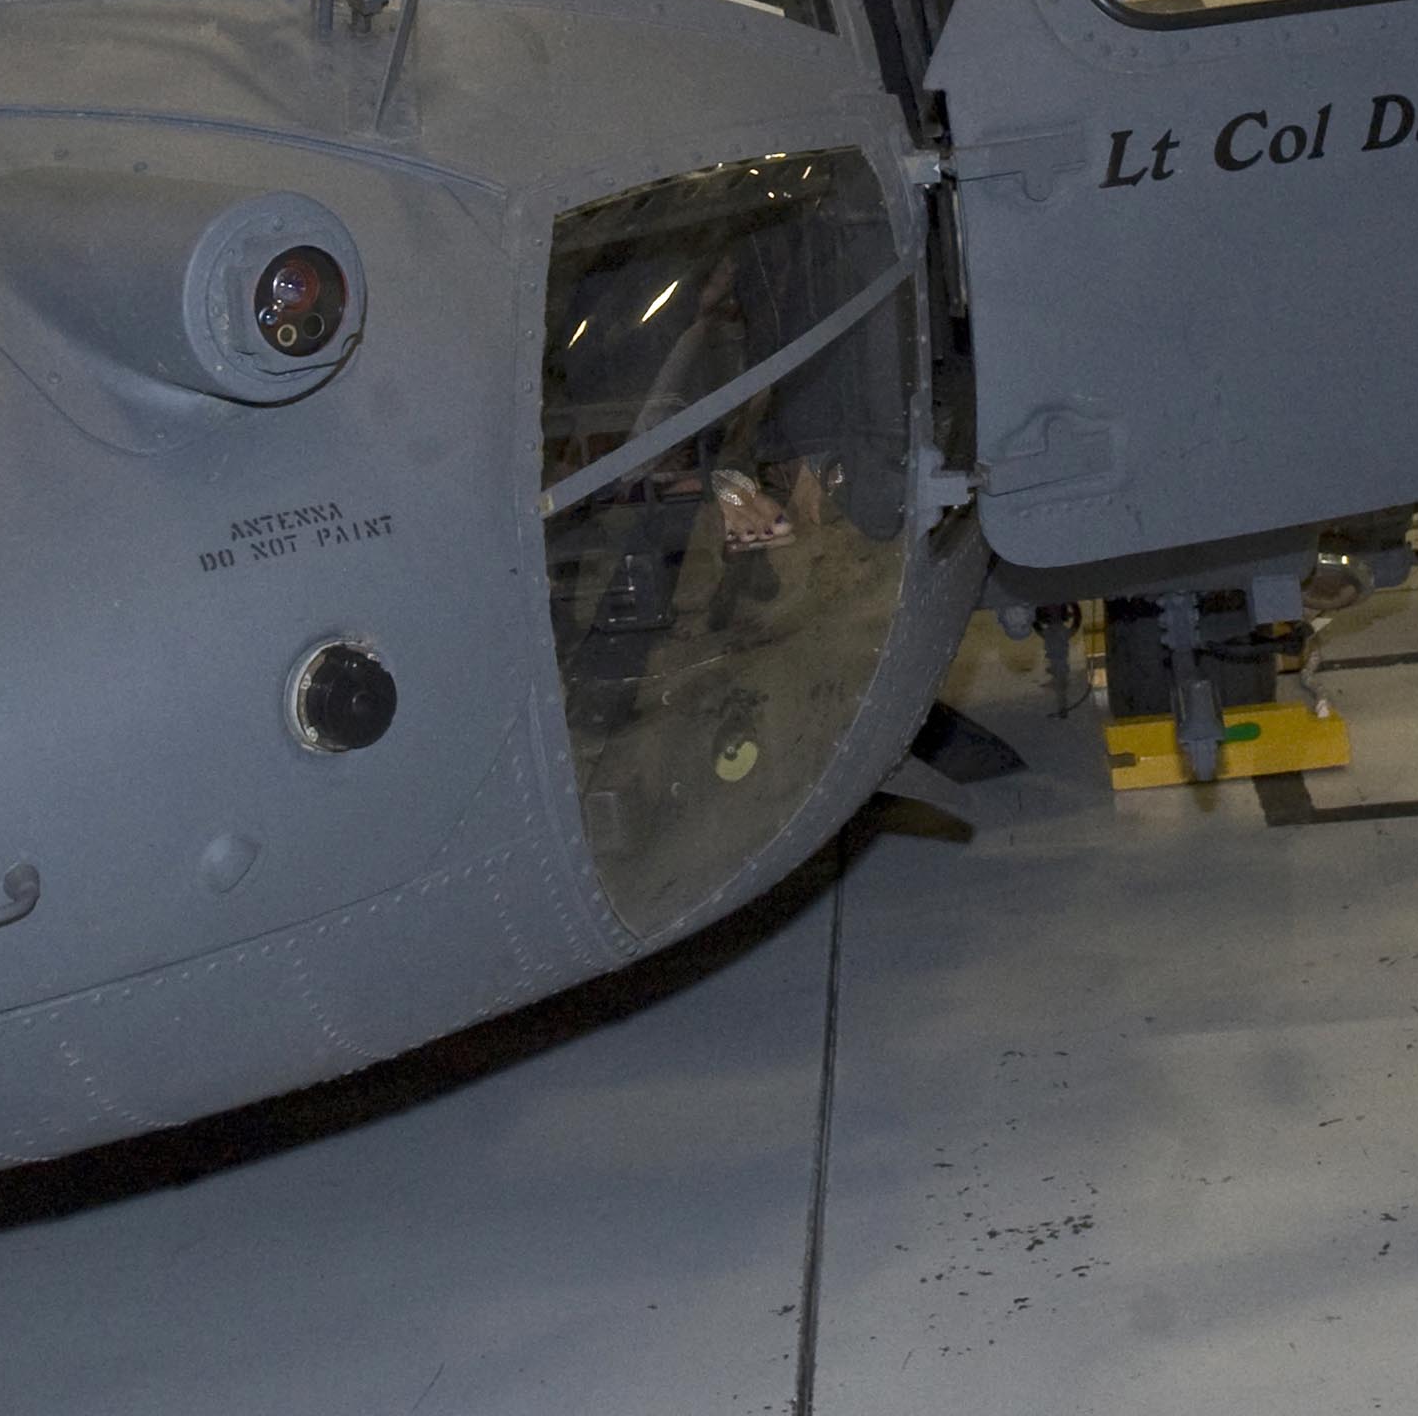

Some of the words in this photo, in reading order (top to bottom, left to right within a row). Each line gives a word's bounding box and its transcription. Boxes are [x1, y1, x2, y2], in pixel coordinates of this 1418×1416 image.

[1100, 127, 1181, 190] Lt
[1213, 103, 1333, 172] Col
[199, 548, 236, 573] DO
[249, 534, 297, 561] NOT
[316, 515, 392, 548] PAINT
[230, 501, 343, 542] ANTENNA
